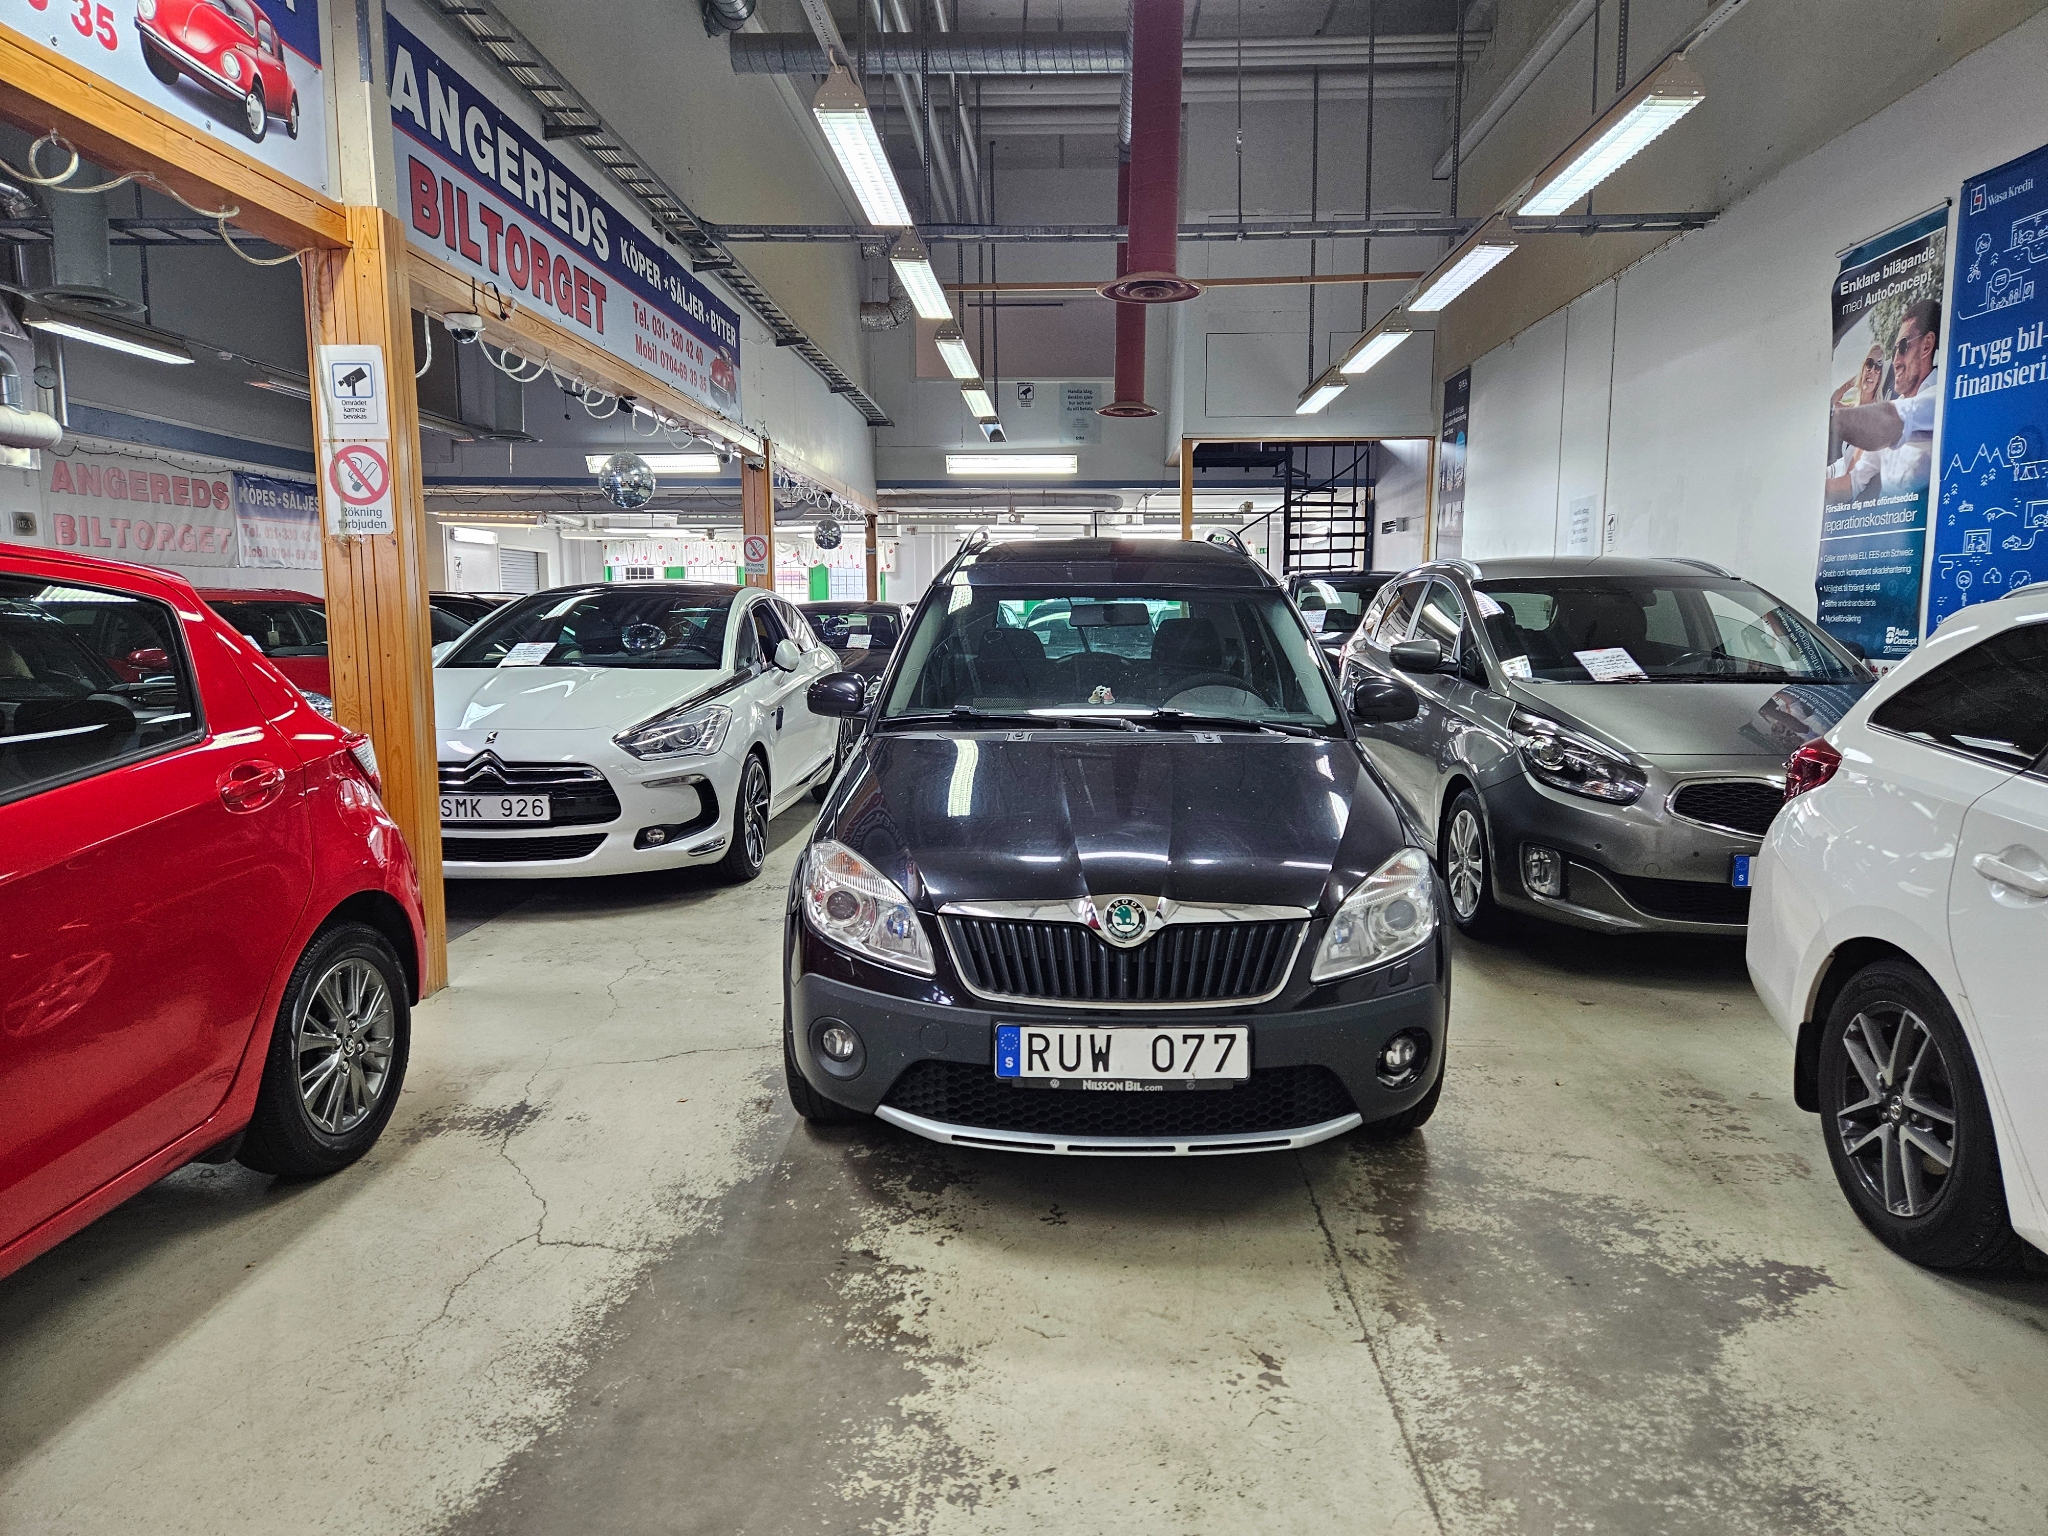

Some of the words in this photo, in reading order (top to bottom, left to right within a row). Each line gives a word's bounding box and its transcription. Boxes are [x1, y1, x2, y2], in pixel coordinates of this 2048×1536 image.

[390, 44, 610, 262] ANGEREDS
[1988, 191, 2007, 205] Wasa
[2008, 178, 2034, 198] Kredit
[408, 154, 607, 335] BILTORGET
[620, 236, 662, 291] KÖPER
[670, 275, 705, 324] SÄLJER
[710, 309, 737, 348] BYTER
[1840, 271, 1880, 296] Enklare
[1882, 247, 1935, 279] bilägande
[1842, 296, 1863, 315] med
[1864, 267, 1933, 307] AutoConcept
[633, 301, 649, 331] Tel.
[686, 339, 694, 360] 42
[696, 346, 703, 366] 40
[1958, 336, 2013, 369] Trygg
[2017, 321, 2048, 352] bil-
[635, 334, 657, 364] Mobil
[690, 369, 697, 387] 39
[1953, 354, 2048, 399] finansieri
[50, 460, 231, 510] ANGEREDS
[238, 484, 276, 507] KÖPES
[1825, 503, 1851, 513] Försäkra
[1852, 501, 1862, 511] dig
[1863, 498, 1876, 508] mot
[53, 513, 231, 554] BILTORGET
[242, 524, 261, 538] Tel.
[1824, 508, 1918, 534] reparationskostnader
[243, 546, 268, 558] Mobil
[1893, 636, 1918, 646] Concept
[1895, 628, 1909, 637] Auto
[441, 798, 482, 818] SMK
[500, 798, 544, 818] 926
[1005, 1057, 1014, 1068] S
[1027, 1033, 1112, 1073] RUW
[1152, 1034, 1237, 1073] 077
